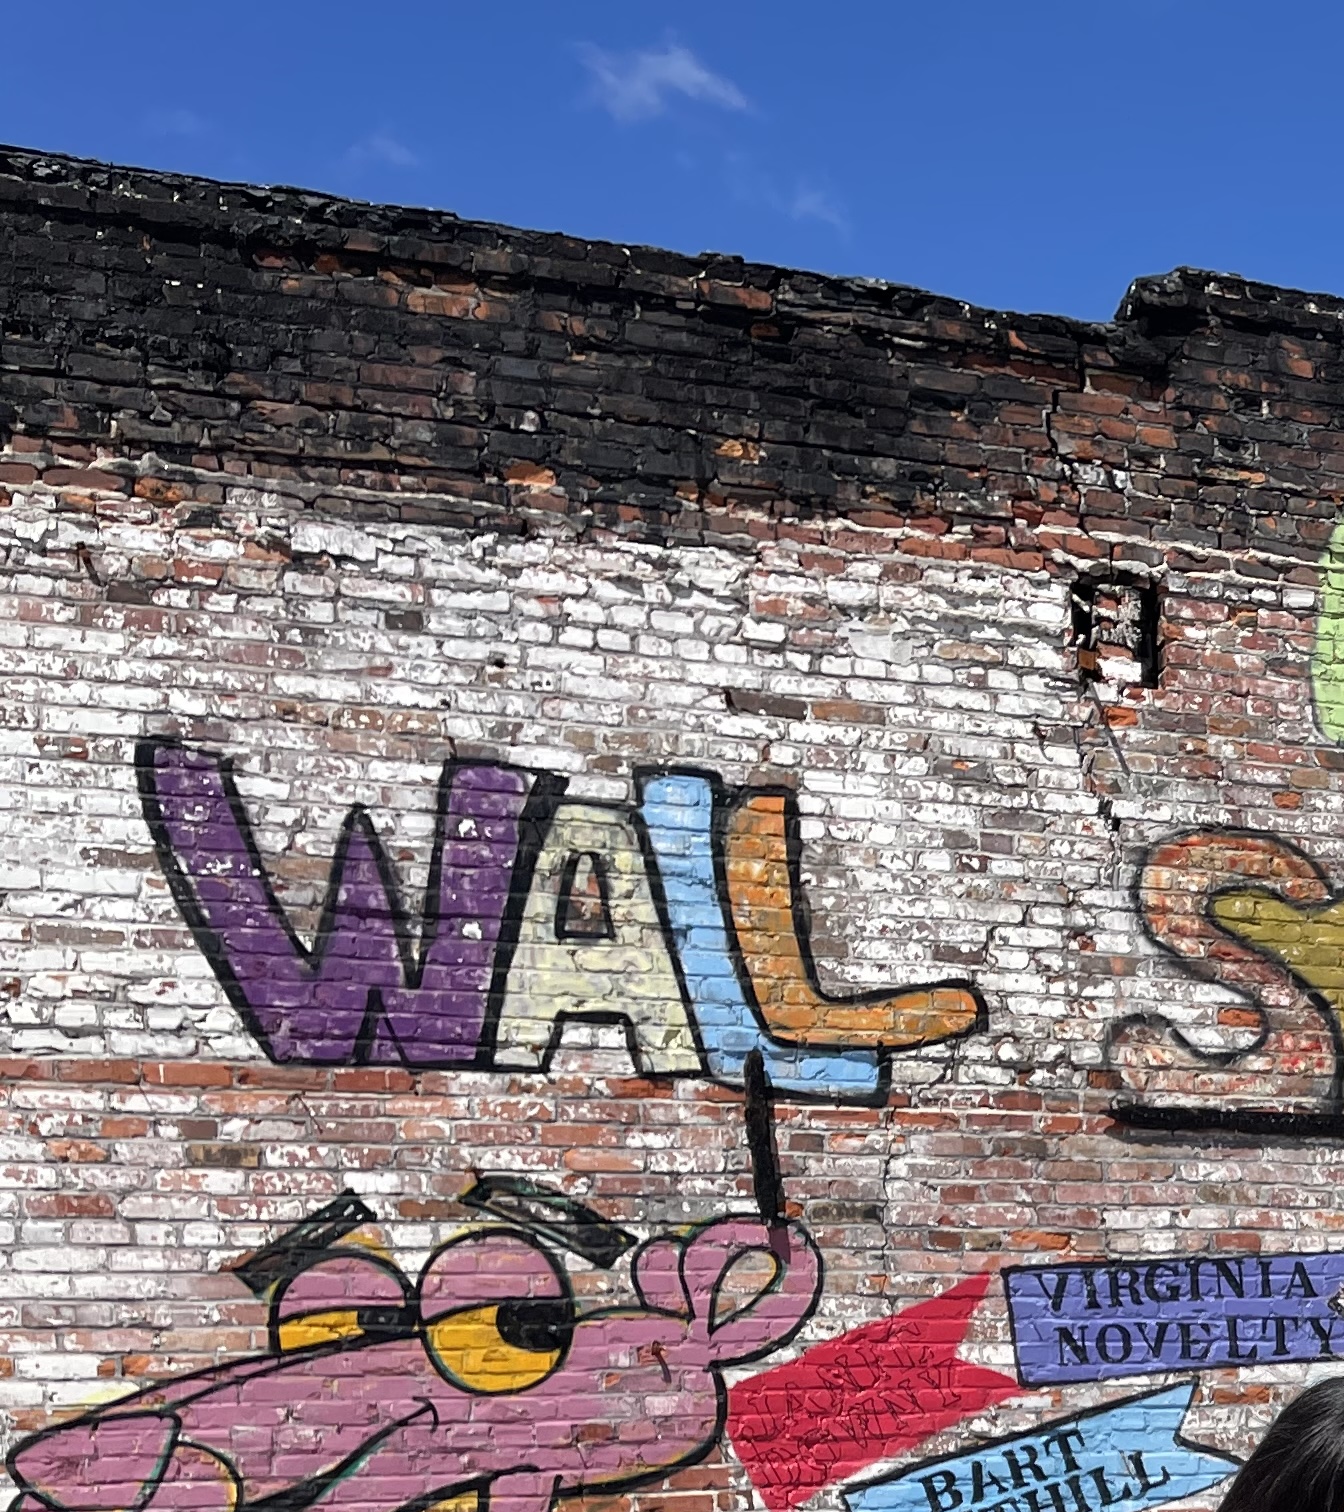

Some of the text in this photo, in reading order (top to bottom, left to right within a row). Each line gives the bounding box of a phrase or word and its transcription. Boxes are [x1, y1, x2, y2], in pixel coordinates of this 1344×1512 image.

[136, 735, 988, 1106] WALL
[1036, 1257, 1318, 1312] VIRGINIA
[1056, 1314, 1340, 1369] NOVELTY
